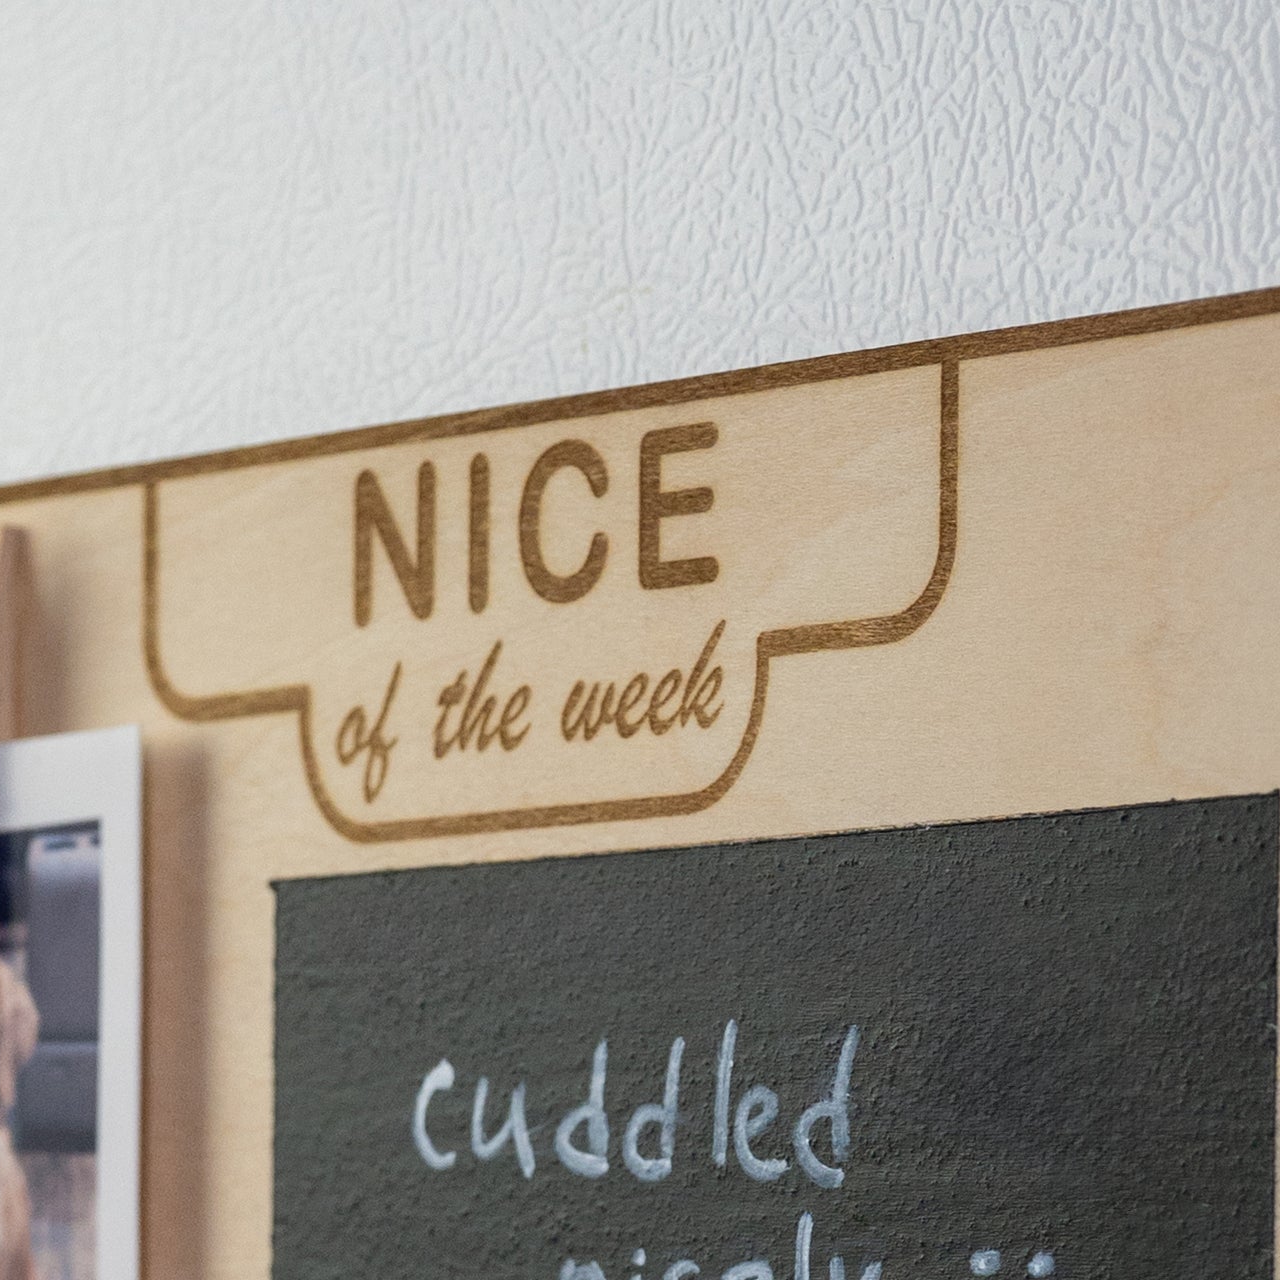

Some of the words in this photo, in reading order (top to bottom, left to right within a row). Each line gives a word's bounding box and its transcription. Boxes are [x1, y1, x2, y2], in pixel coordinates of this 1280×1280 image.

[352, 421, 721, 628] NICE
[335, 661, 403, 803] of
[431, 639, 532, 761] the
[560, 617, 727, 741] week
[412, 1018, 859, 1188] cuddled
